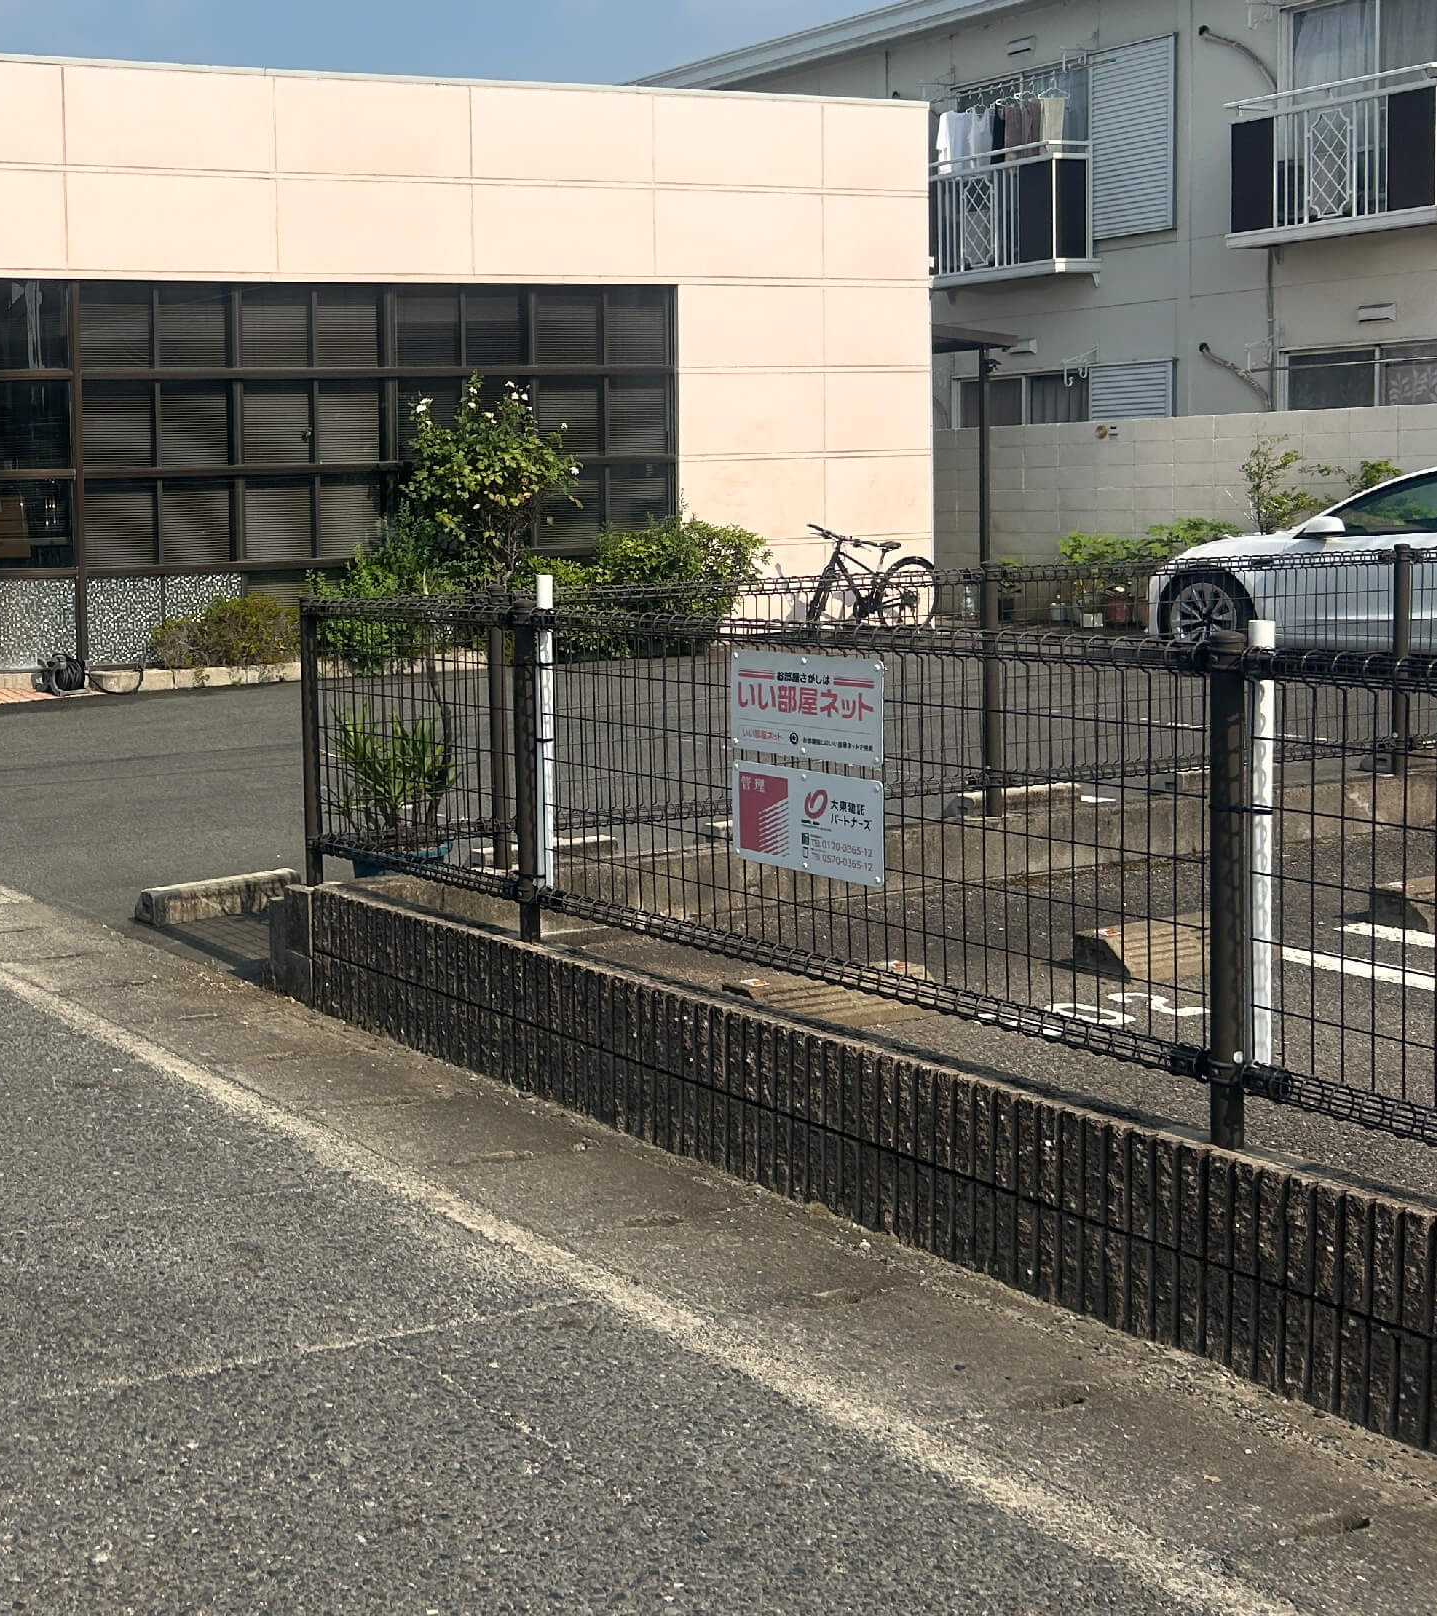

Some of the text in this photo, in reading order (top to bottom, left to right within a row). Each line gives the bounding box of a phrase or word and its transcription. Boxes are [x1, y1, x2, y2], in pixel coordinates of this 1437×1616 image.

[737, 681, 875, 721] いい部屋ネット
[740, 776, 765, 792] 管理
[830, 800, 866, 816] 大東建託
[830, 813, 873, 831] パートナーズ
